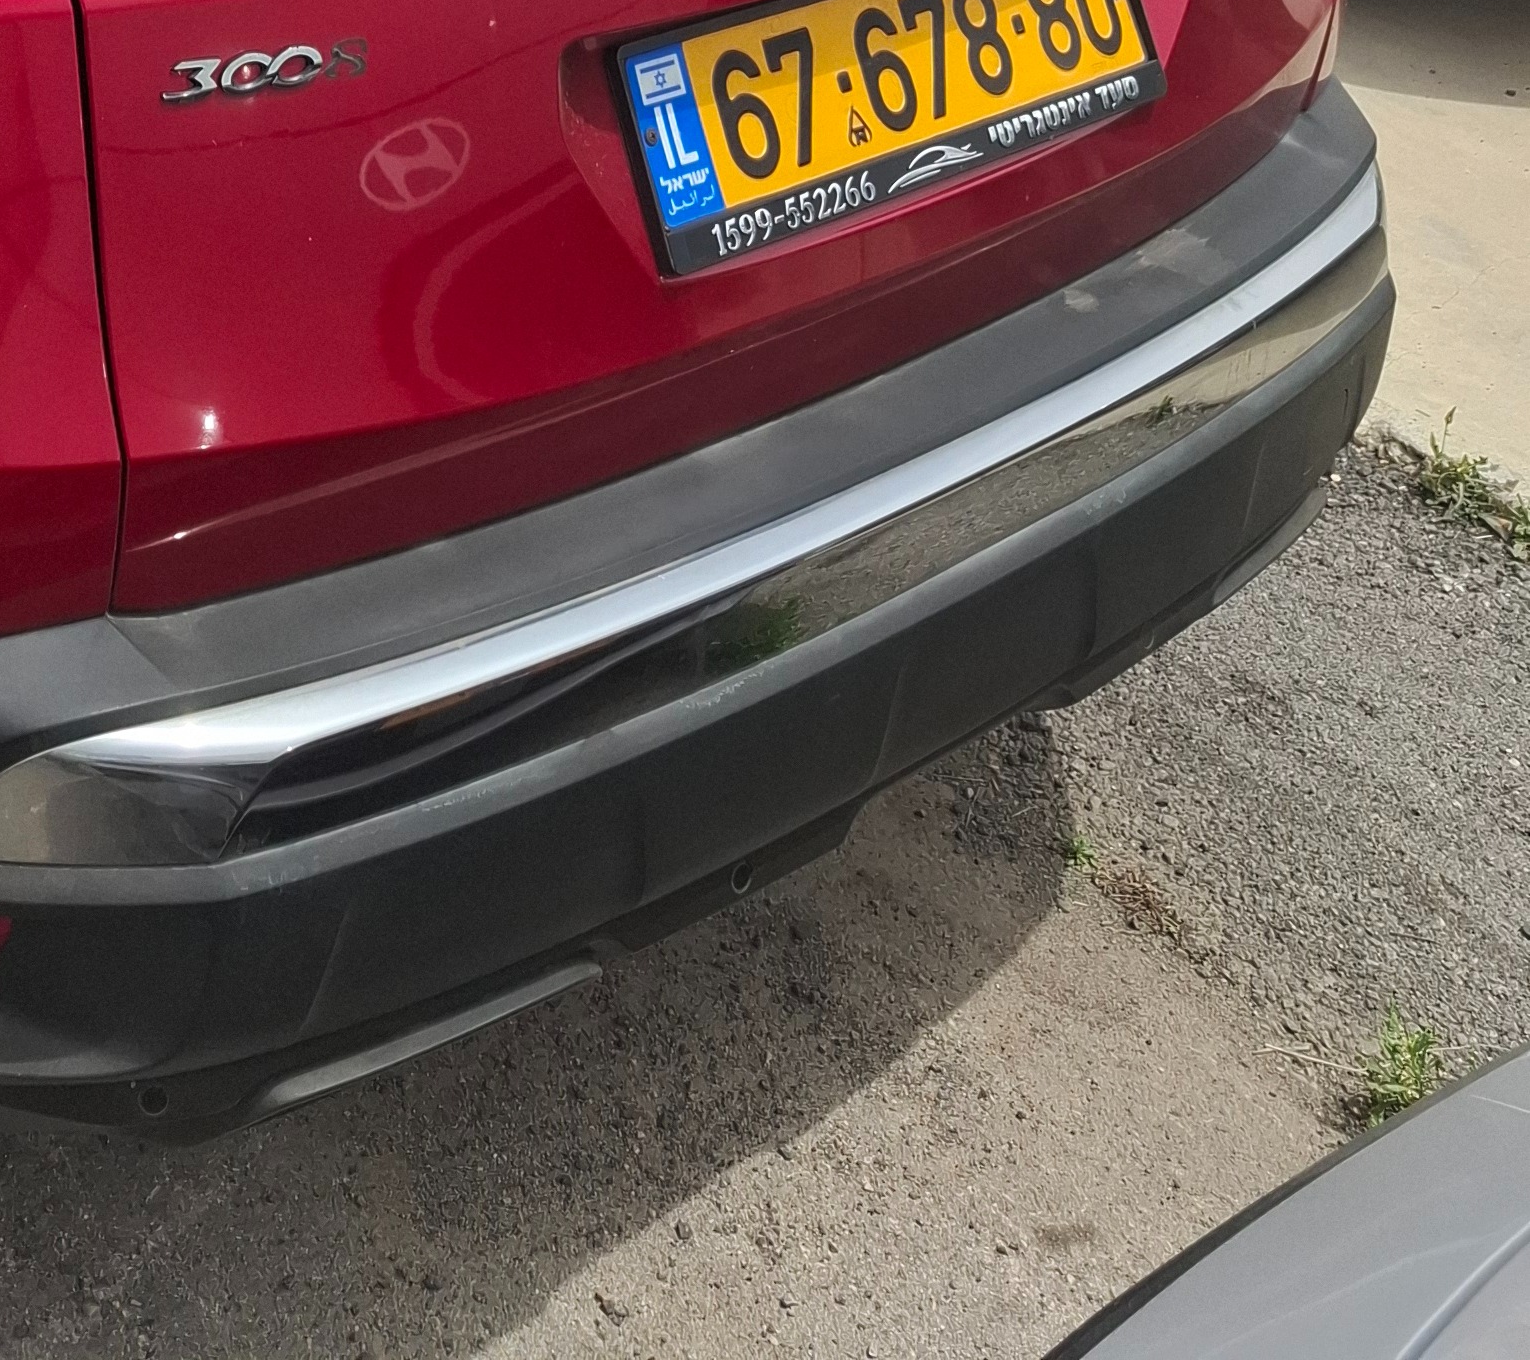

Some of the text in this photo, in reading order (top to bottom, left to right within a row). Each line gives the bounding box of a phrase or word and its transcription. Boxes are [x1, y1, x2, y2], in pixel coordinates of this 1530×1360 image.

[654, 103, 699, 169] IL
[988, 92, 1091, 147] אינטגריטי
[660, 168, 709, 194] ישראל
[711, 171, 876, 256] 1599-552266
